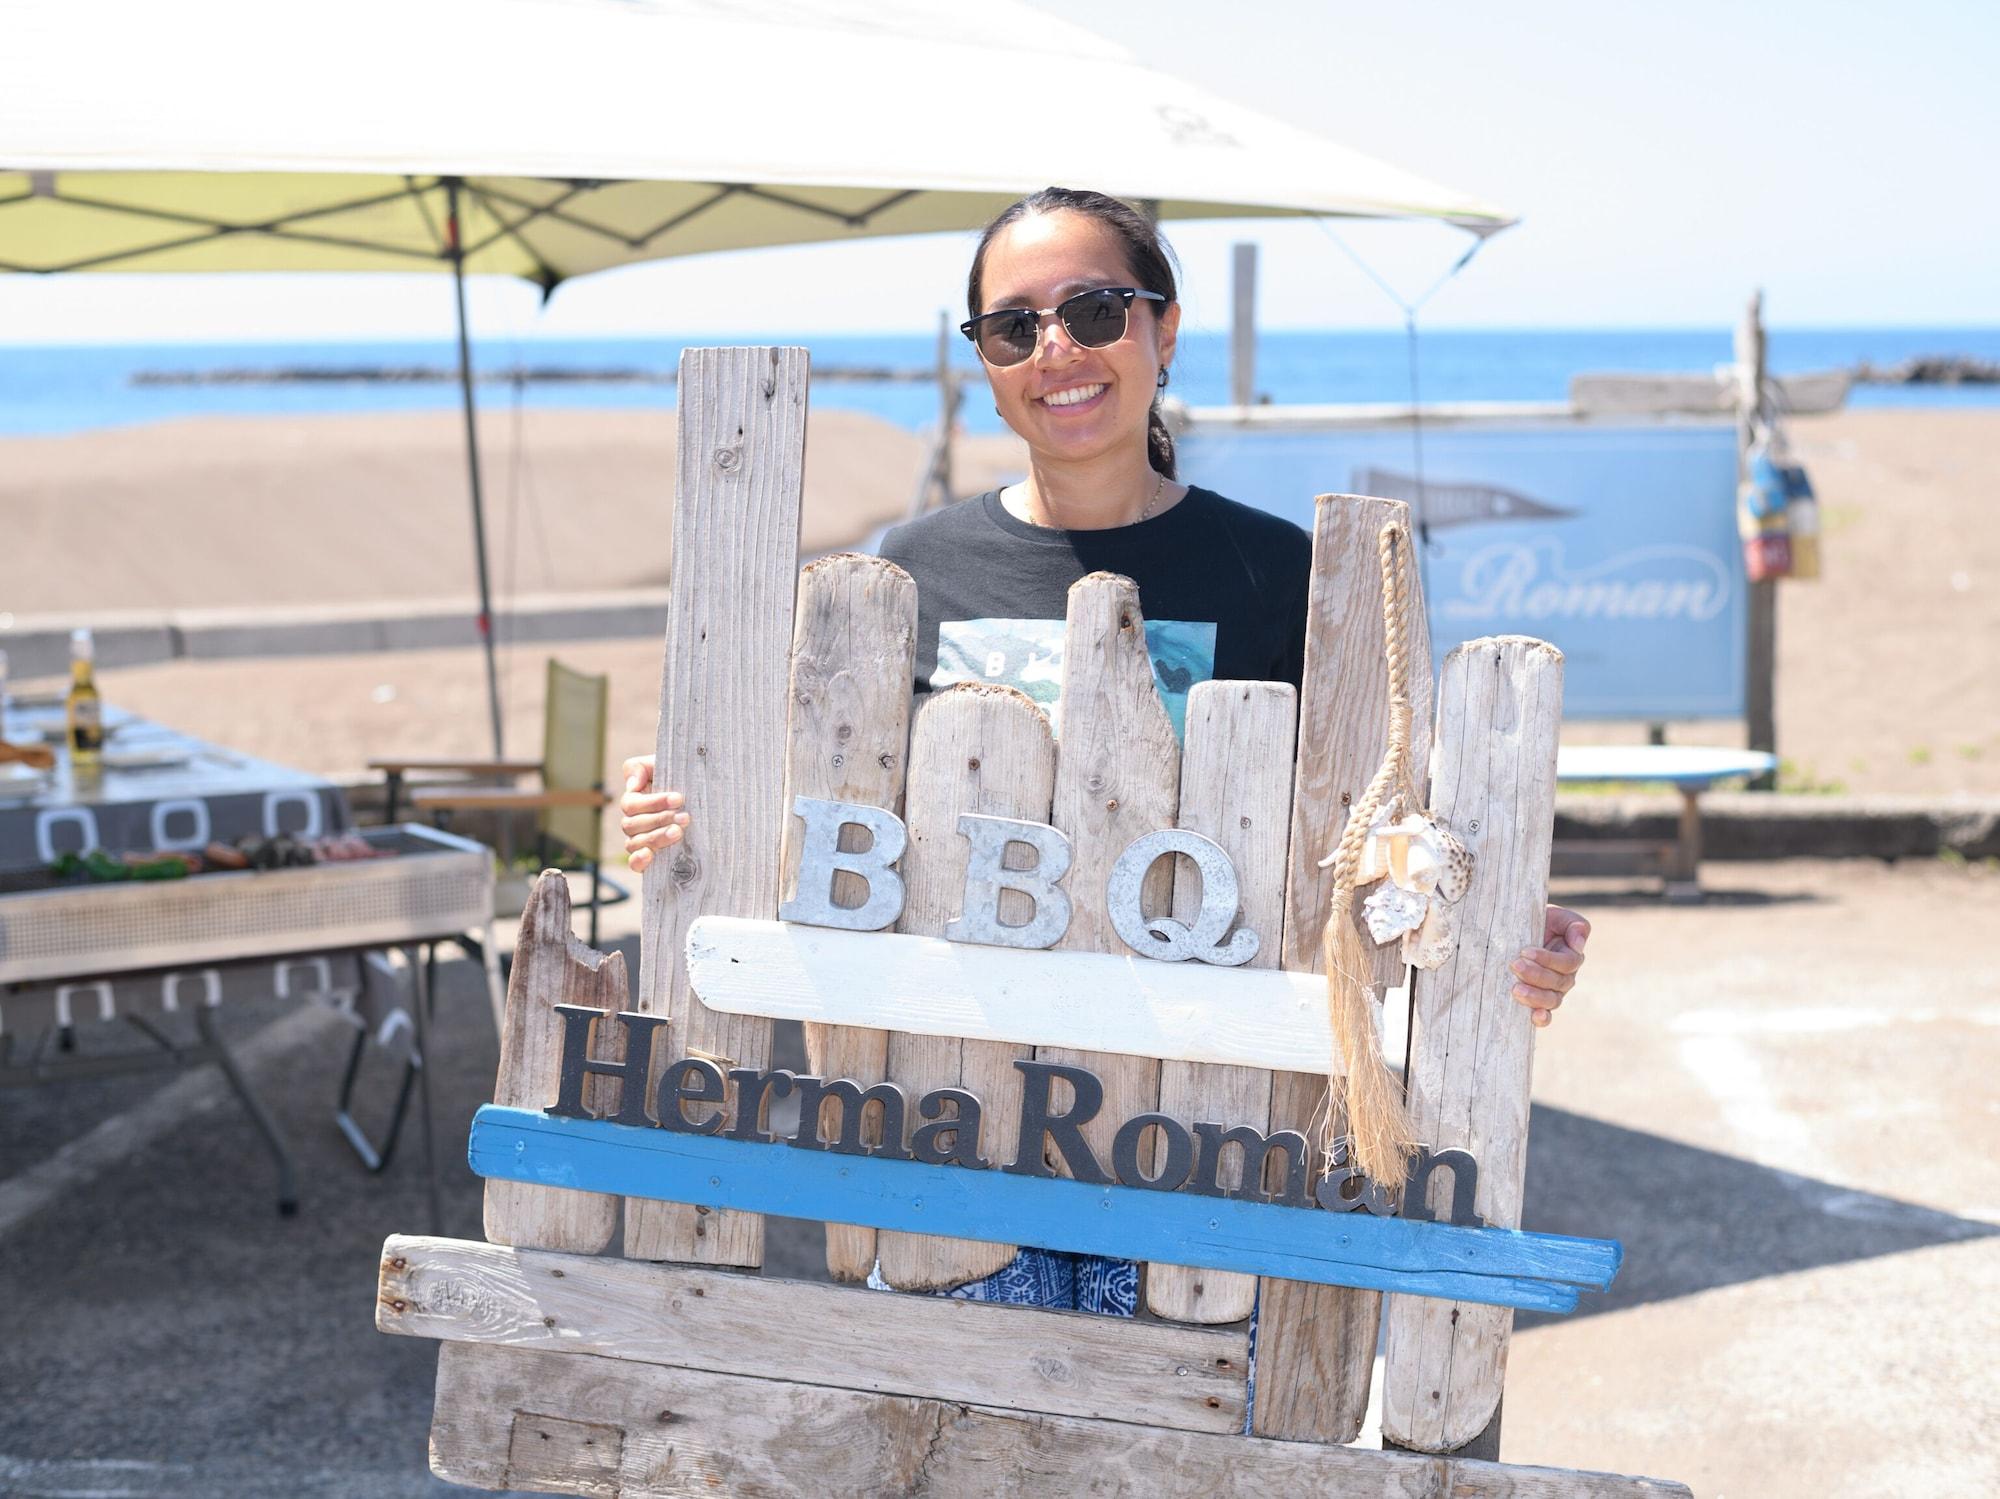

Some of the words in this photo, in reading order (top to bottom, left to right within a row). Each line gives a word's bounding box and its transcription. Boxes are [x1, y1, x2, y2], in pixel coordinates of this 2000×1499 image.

[1434, 534, 1730, 622] Roman
[778, 794, 1261, 966] BBQ
[543, 1003, 990, 1170] Herma
[1001, 1059, 1485, 1227] Roman
